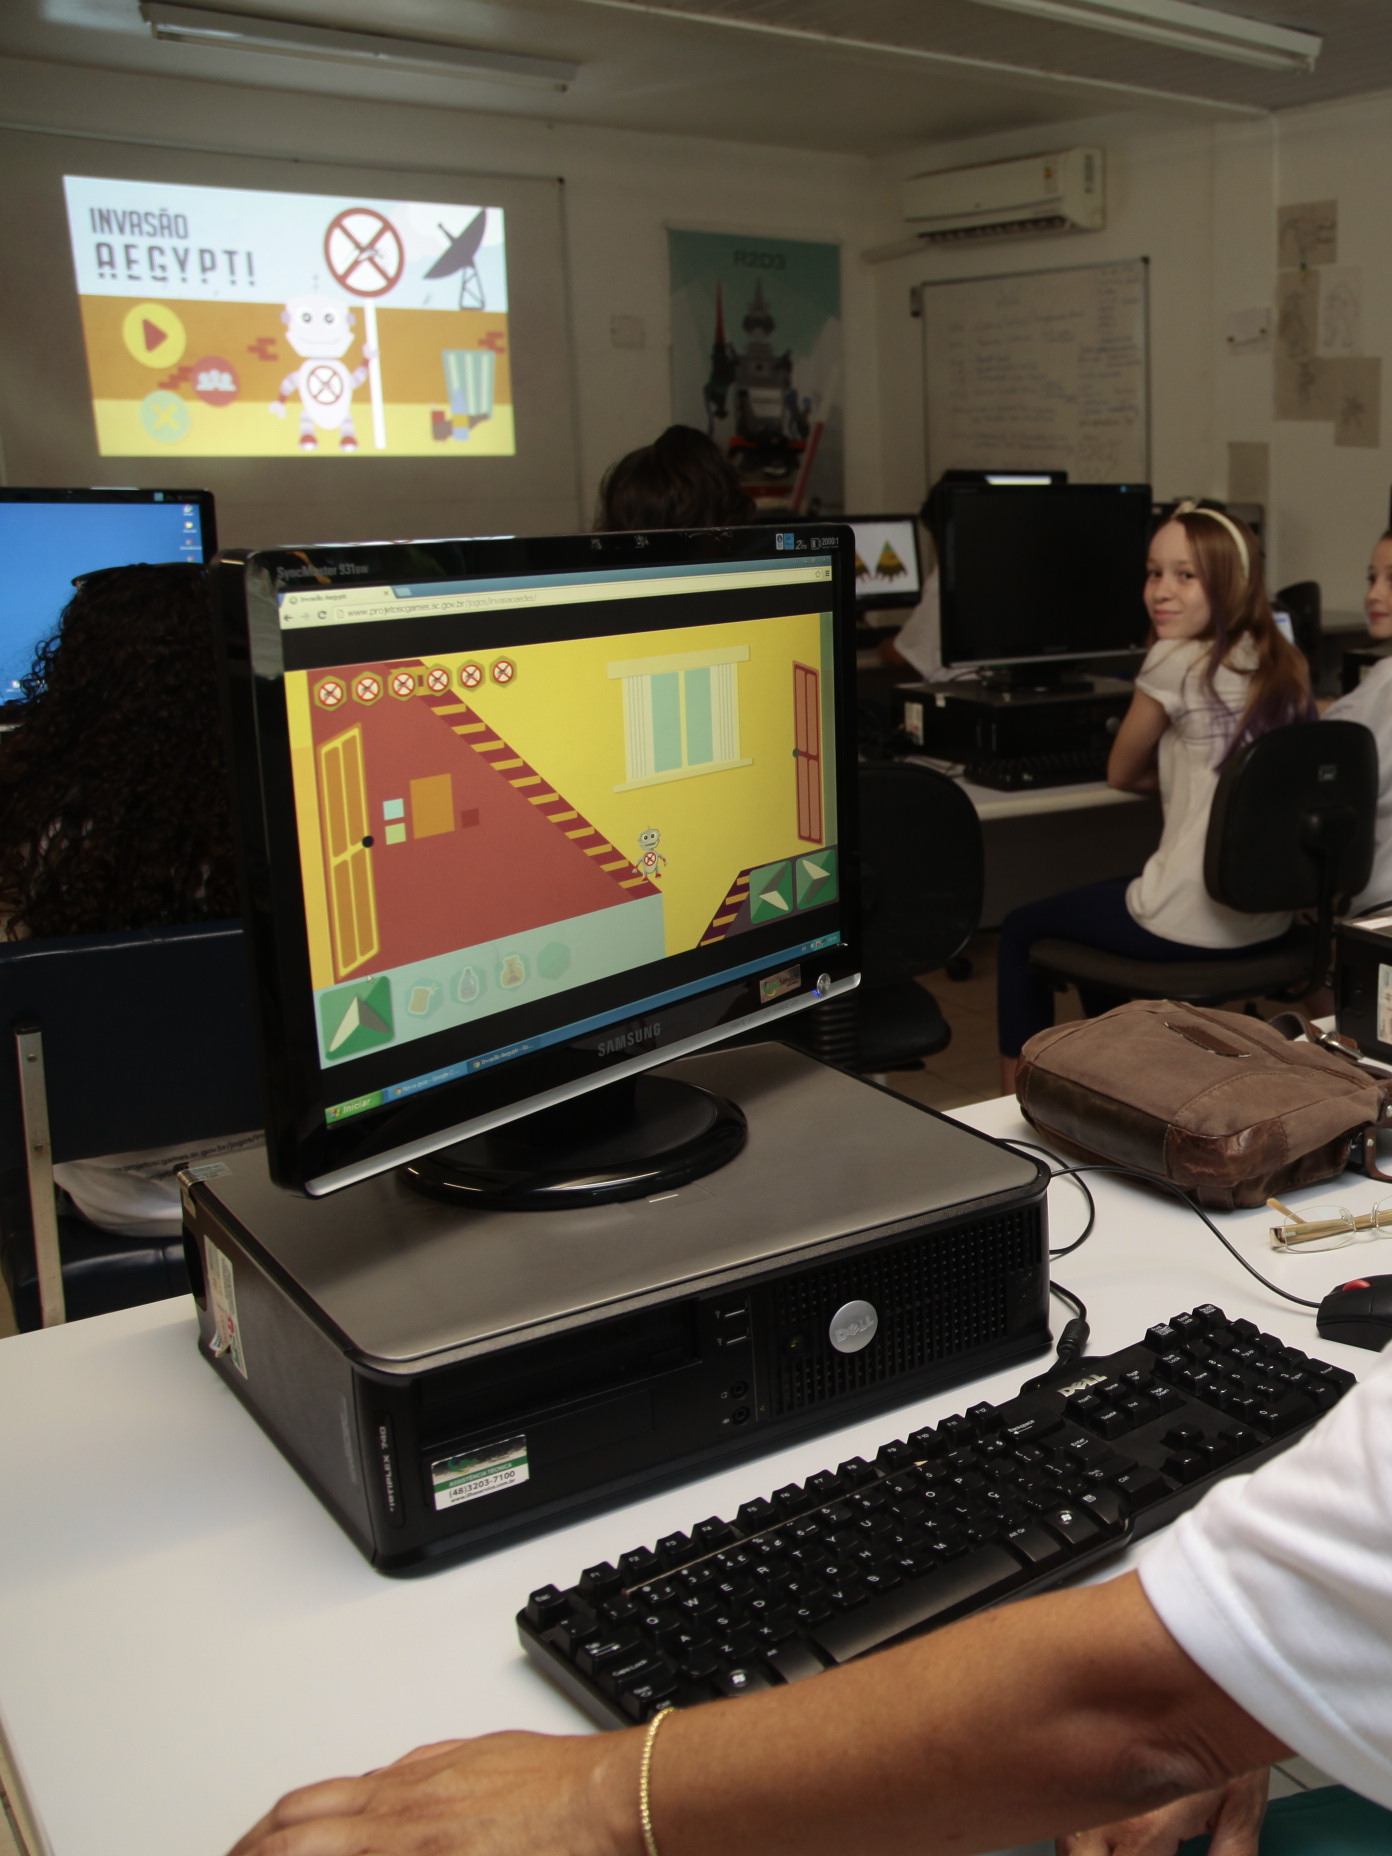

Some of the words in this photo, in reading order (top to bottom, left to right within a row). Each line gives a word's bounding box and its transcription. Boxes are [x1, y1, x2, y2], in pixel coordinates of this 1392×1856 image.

[90, 207, 189, 239] INVASÃO
[733, 249, 787, 270] R2D3
[597, 1022, 661, 1057] SAMSUNG
[342, 1097, 372, 1114] Iniciar
[833, 1314, 875, 1343] DELL
[1057, 1373, 1108, 1398] DELL
[379, 1426, 388, 1450] 740
[449, 1470, 515, 1498] (48)3203-7100
[534, 1594, 550, 1602] Esc
